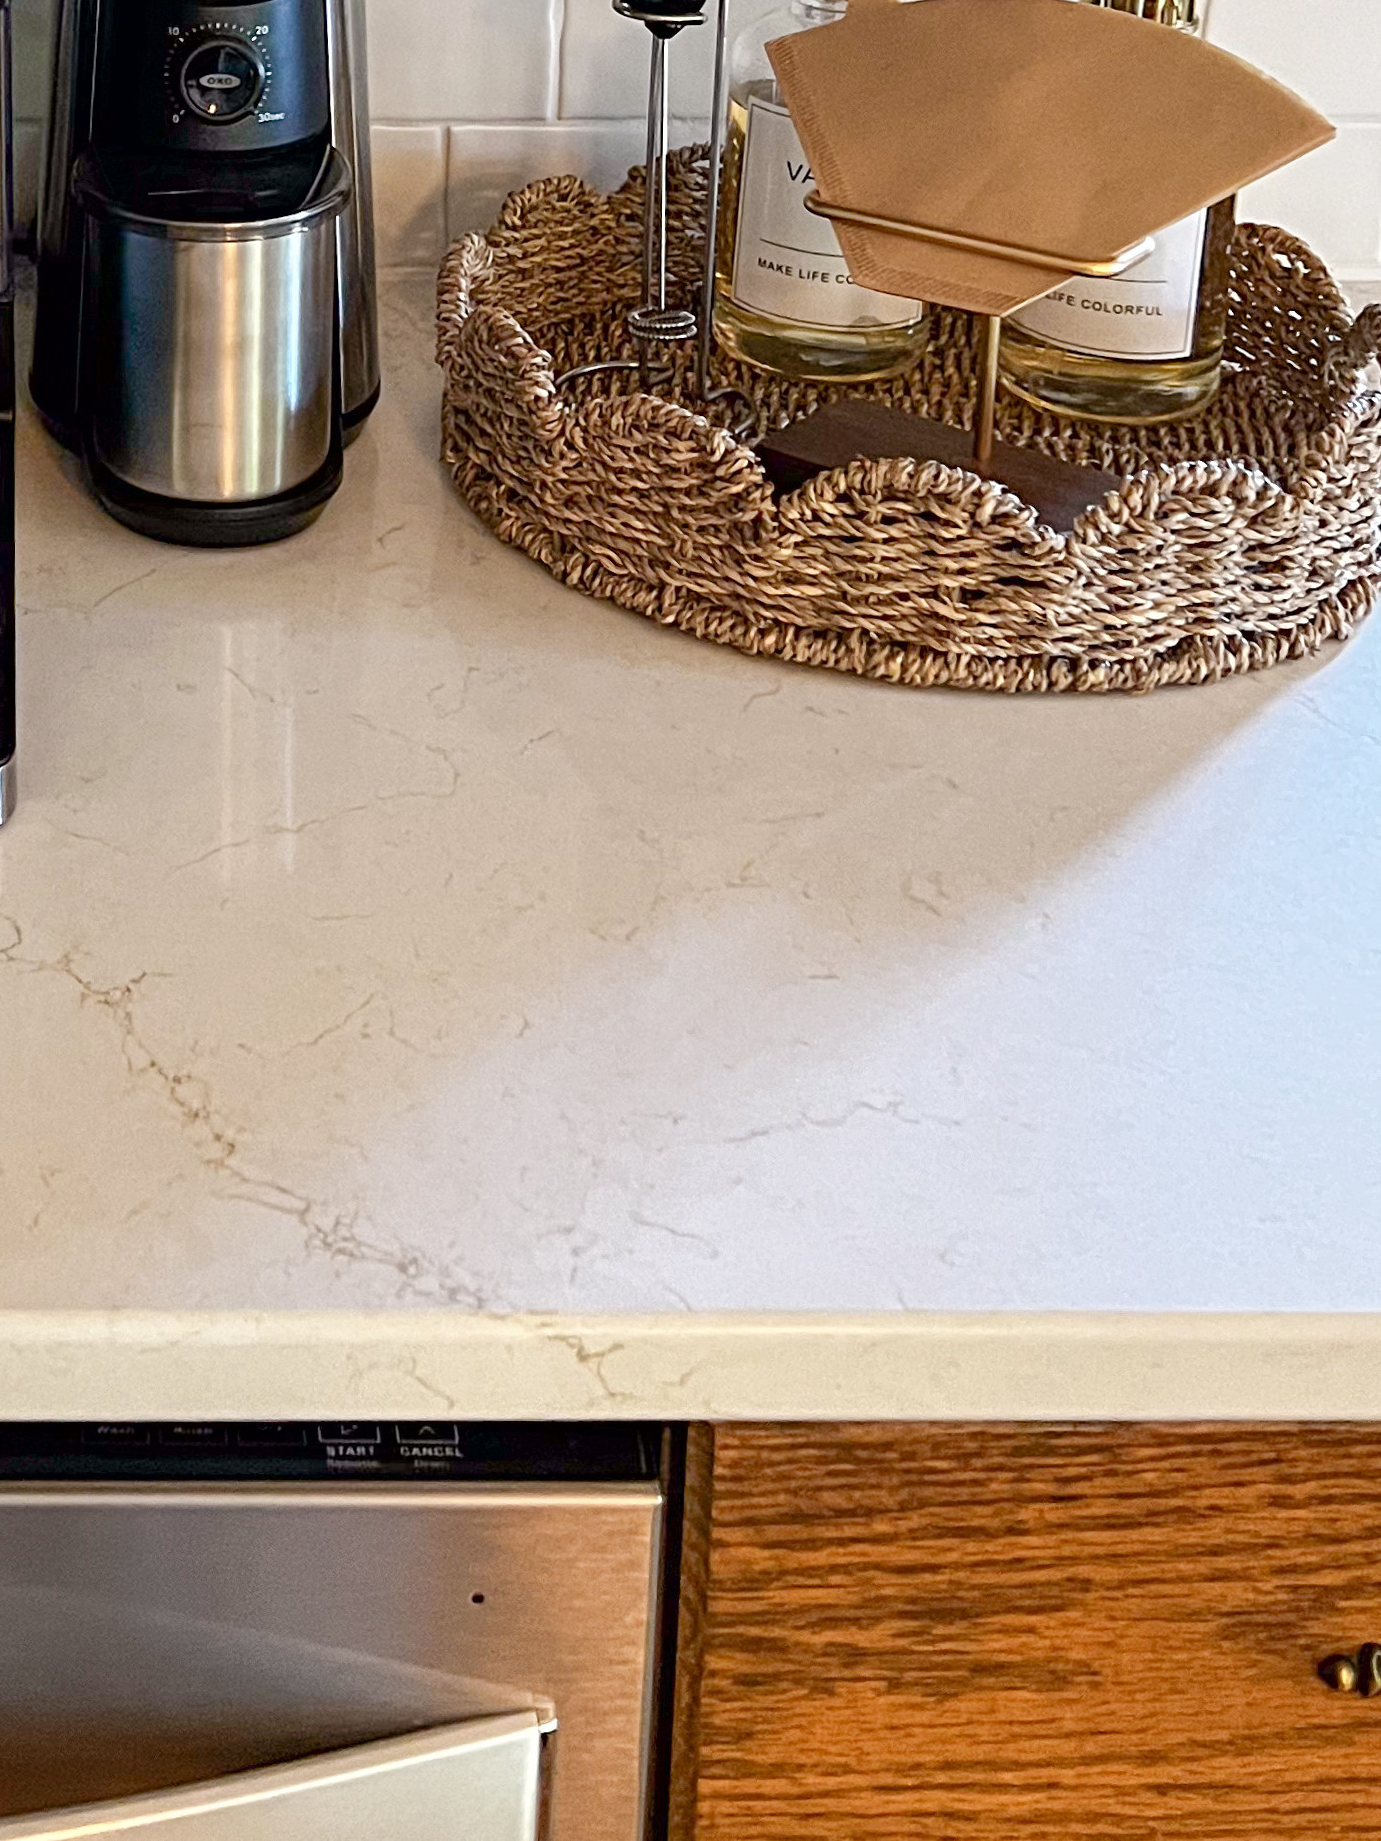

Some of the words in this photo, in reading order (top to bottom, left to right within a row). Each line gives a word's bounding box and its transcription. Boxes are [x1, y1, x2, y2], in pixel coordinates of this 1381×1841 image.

[167, 26, 180, 36] 10
[254, 25, 270, 36] 20
[206, 77, 233, 86] OXO
[757, 257, 794, 277] MAKE
[798, 268, 831, 283] LIFE
[1080, 299, 1163, 316] COLORFUL
[325, 1445, 376, 1458] START
[399, 1445, 465, 1459] CANCEL
